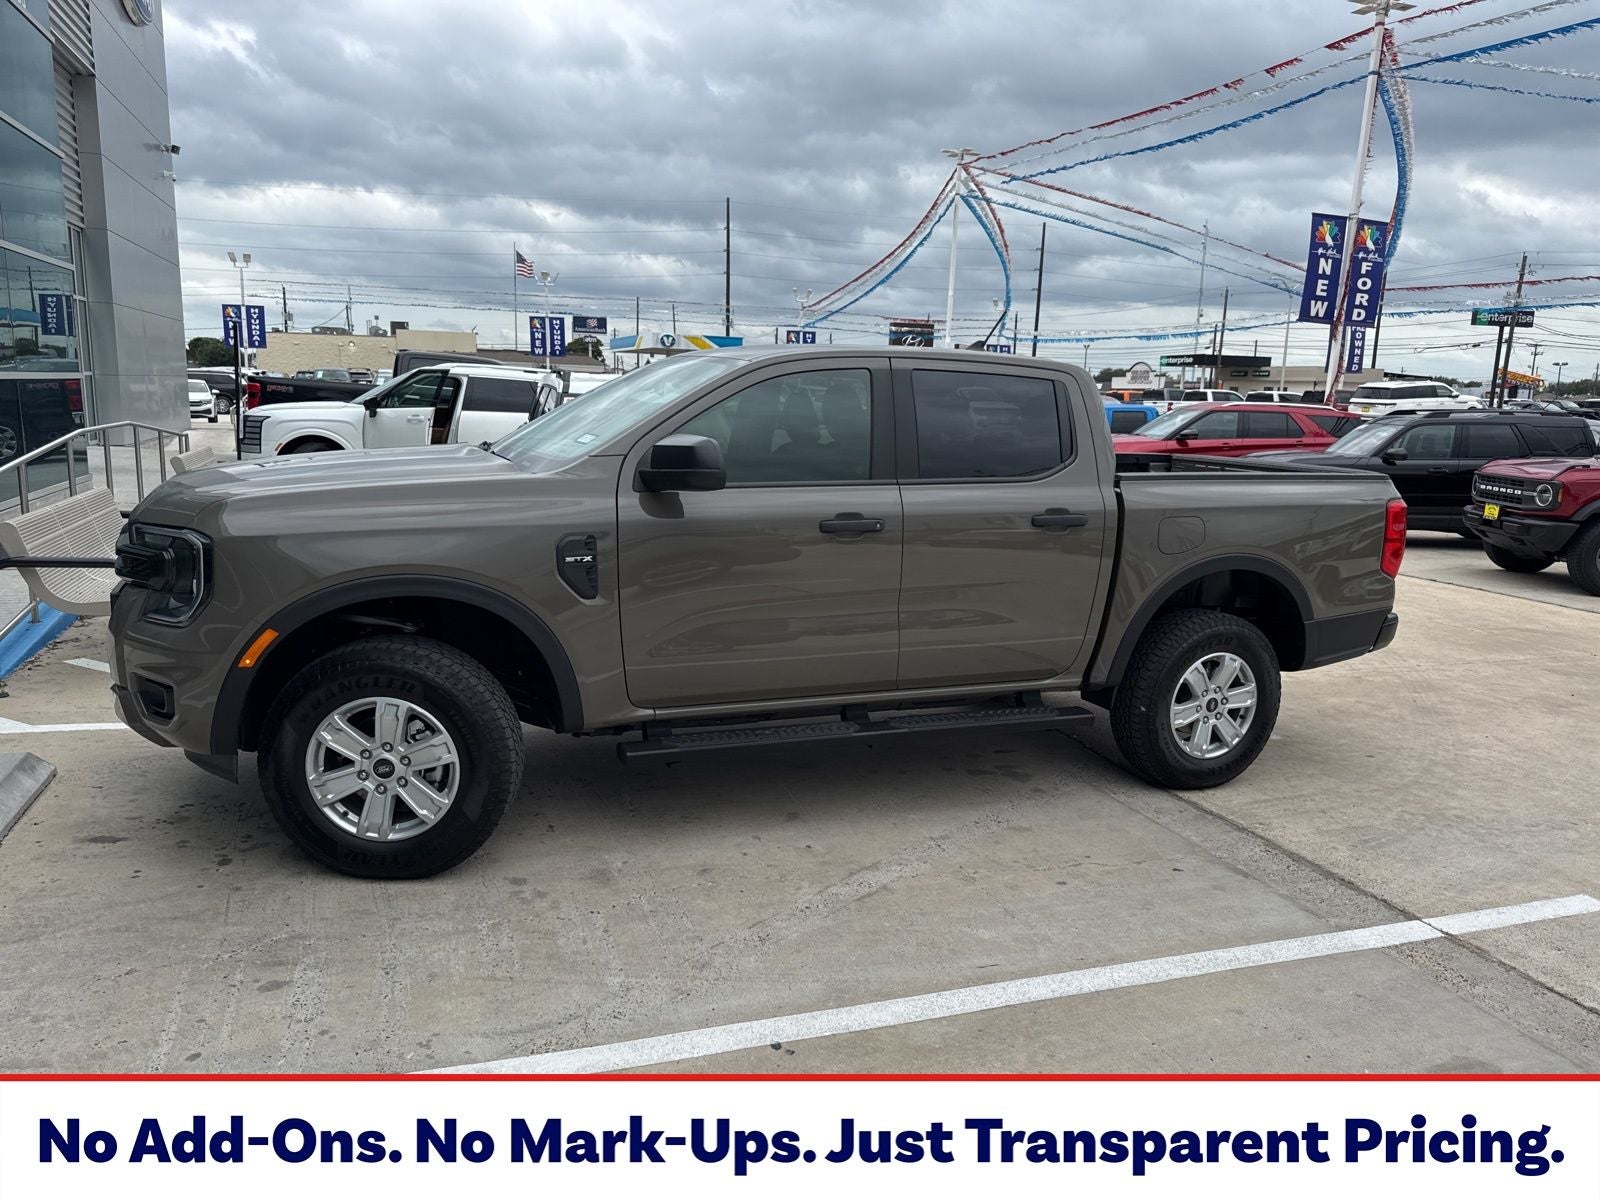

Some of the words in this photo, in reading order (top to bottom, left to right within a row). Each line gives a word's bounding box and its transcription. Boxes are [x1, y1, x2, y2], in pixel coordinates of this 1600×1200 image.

[1310, 257, 1332, 318] NEW
[1351, 262, 1373, 322] FORD
[250, 308, 261, 346] HYUNDAI
[533, 332, 544, 355] NEW
[553, 319, 562, 355] HYUNDAI
[1351, 332, 1363, 371] OWNED
[1480, 484, 1522, 495] BRONCO
